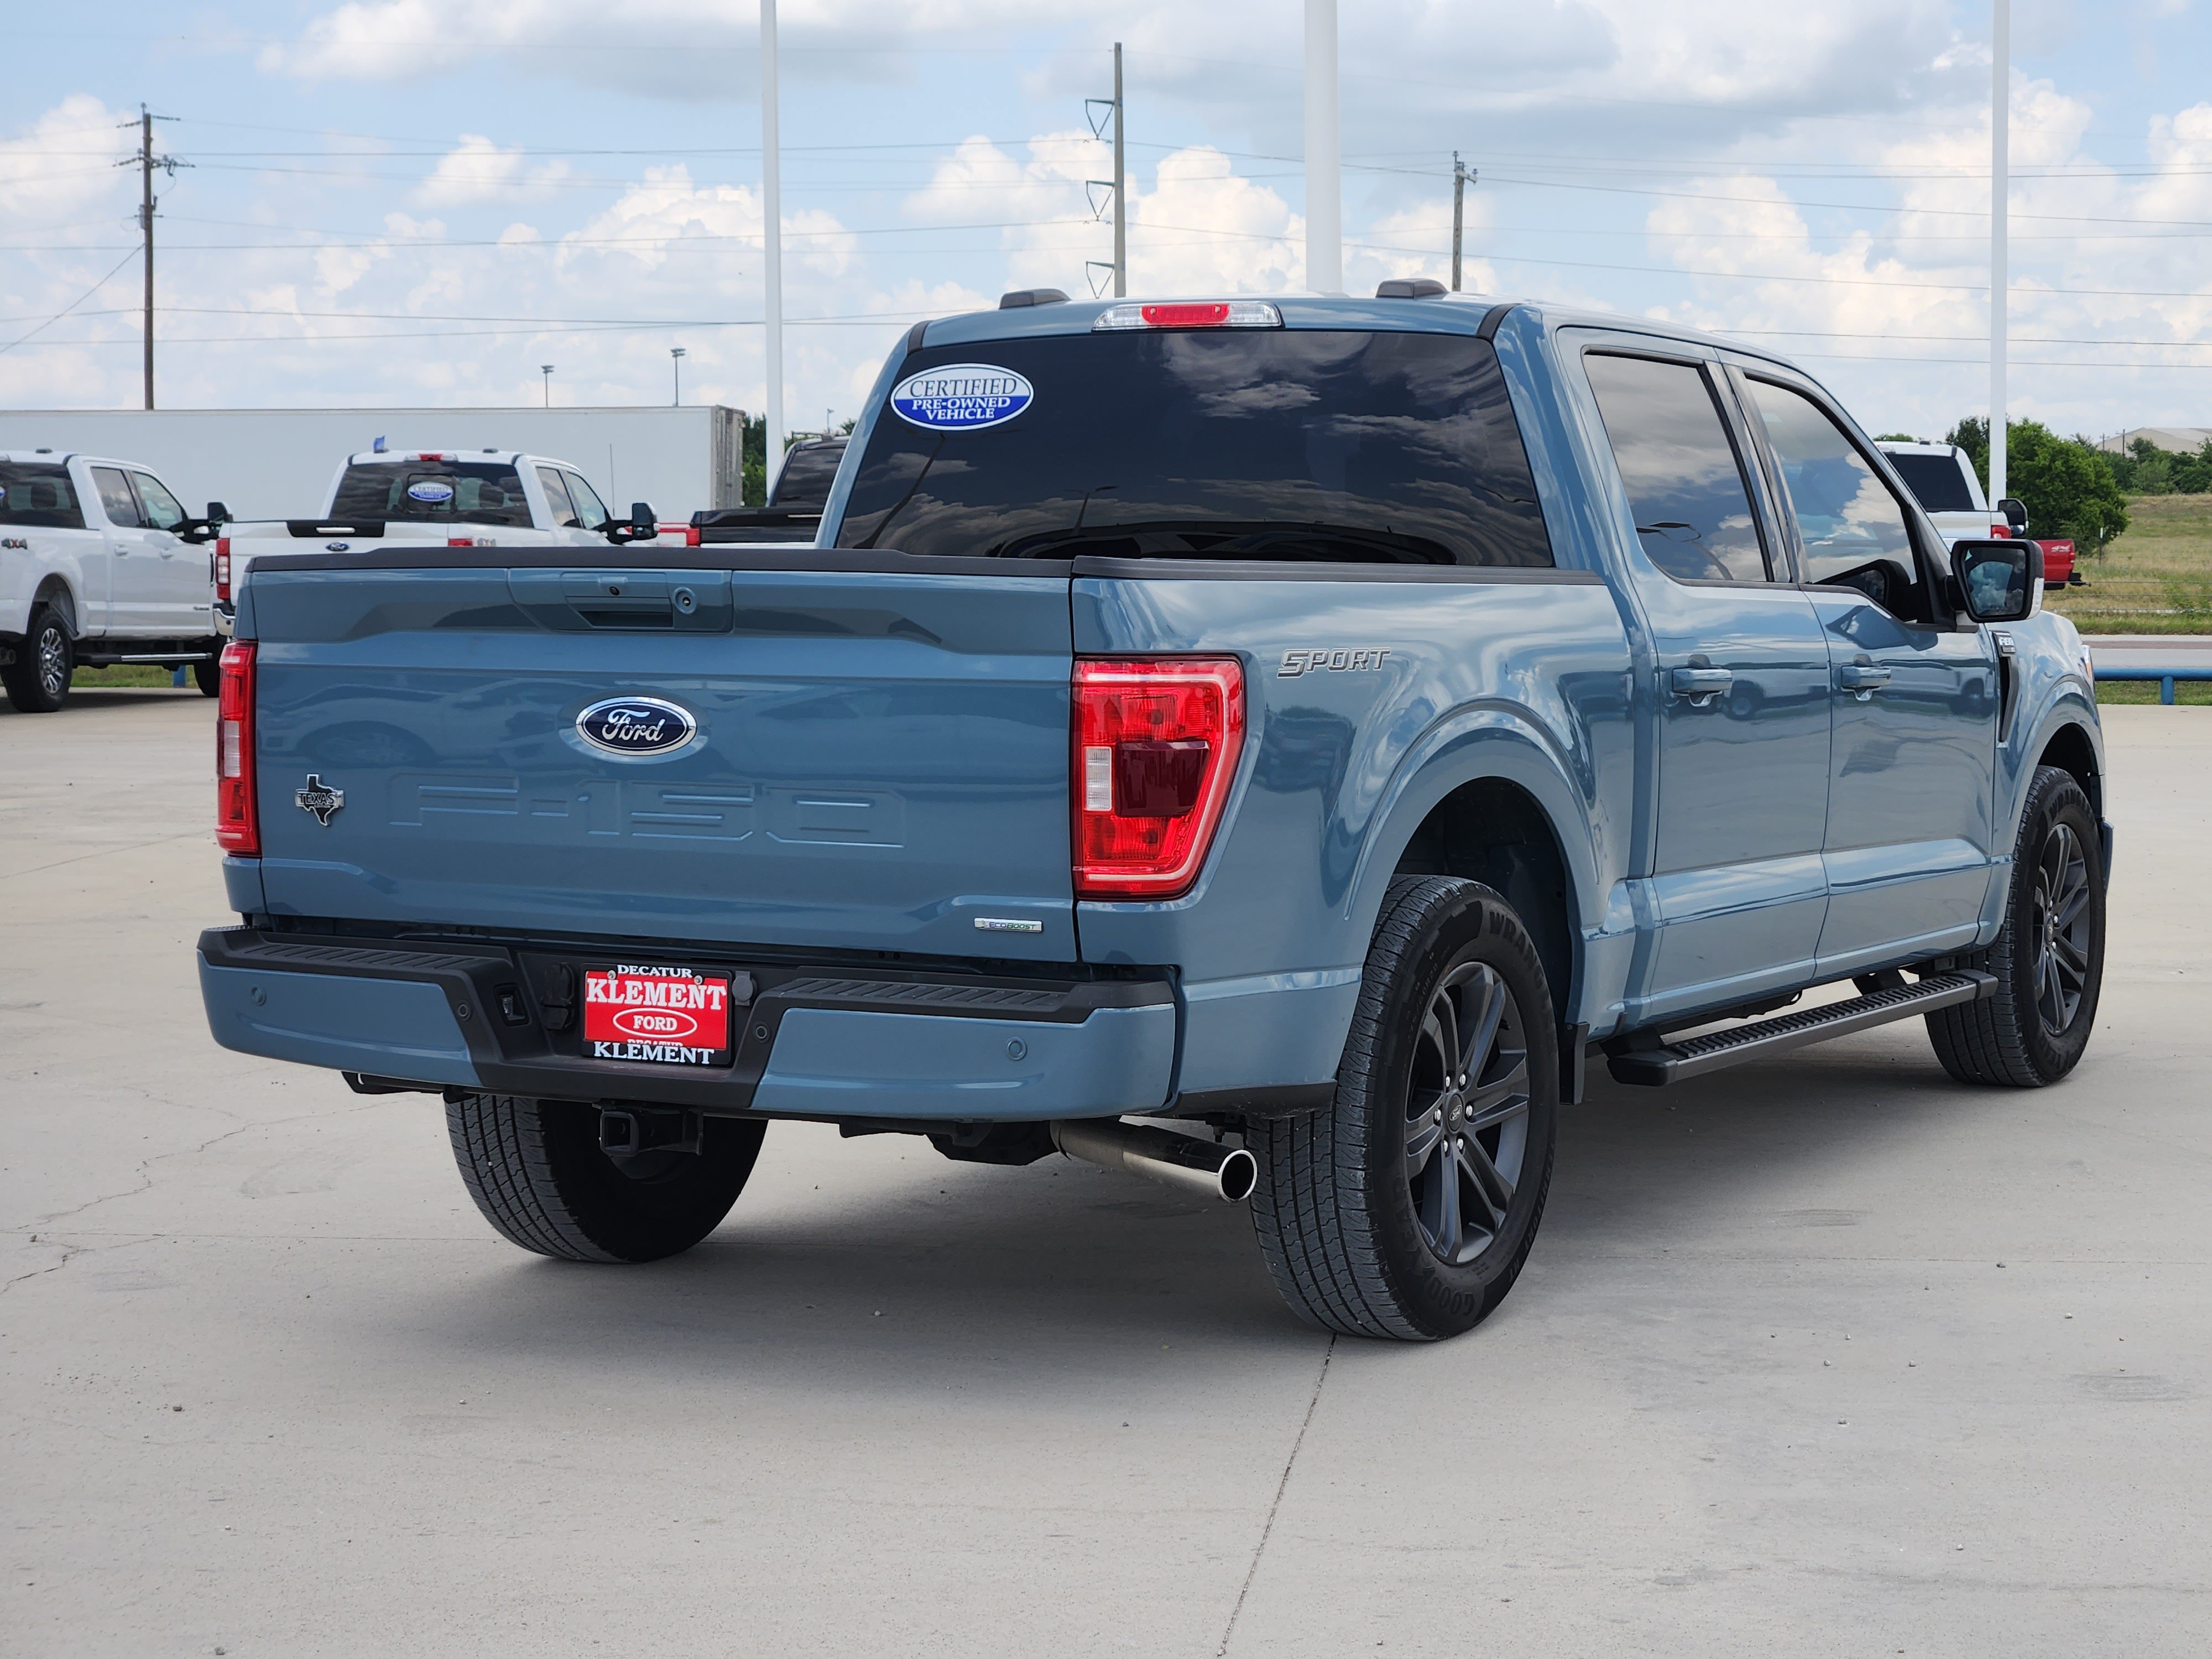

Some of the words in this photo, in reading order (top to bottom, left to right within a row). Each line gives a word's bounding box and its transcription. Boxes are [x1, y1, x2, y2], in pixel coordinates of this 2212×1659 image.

[909, 378, 1017, 397] CERTIFIED
[912, 397, 1011, 410] PRE-OWNED
[926, 408, 995, 420] VEHICLE
[1276, 647, 1391, 679] SPORT
[602, 708, 666, 742] Ford
[298, 793, 335, 805] TEXAS
[989, 921, 1036, 930] ECOBOOST
[617, 964, 693, 978] DECATUR
[586, 978, 727, 1010] KLEMENT
[633, 1015, 677, 1031] FORD
[593, 1041, 715, 1065] KLEMENT
